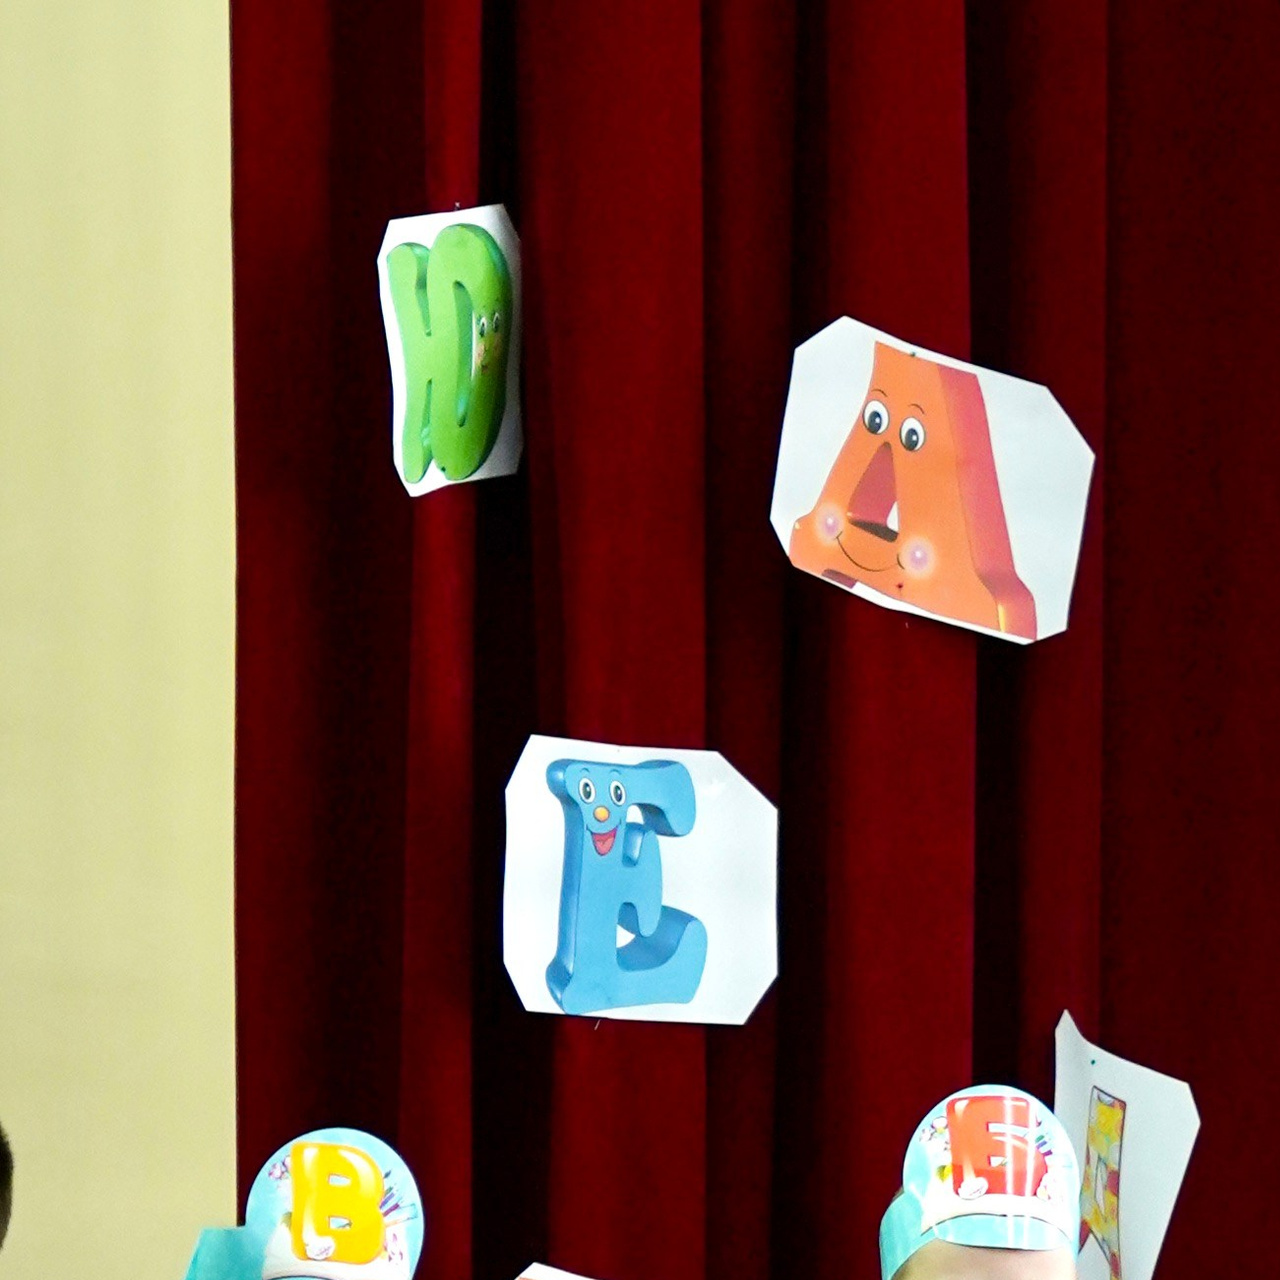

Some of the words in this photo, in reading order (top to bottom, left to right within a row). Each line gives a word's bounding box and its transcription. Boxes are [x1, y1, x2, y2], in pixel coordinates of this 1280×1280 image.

[387, 223, 513, 484] Ю
[789, 340, 1037, 642] А
[545, 758, 708, 1015] Е
[290, 1142, 386, 1265] В
